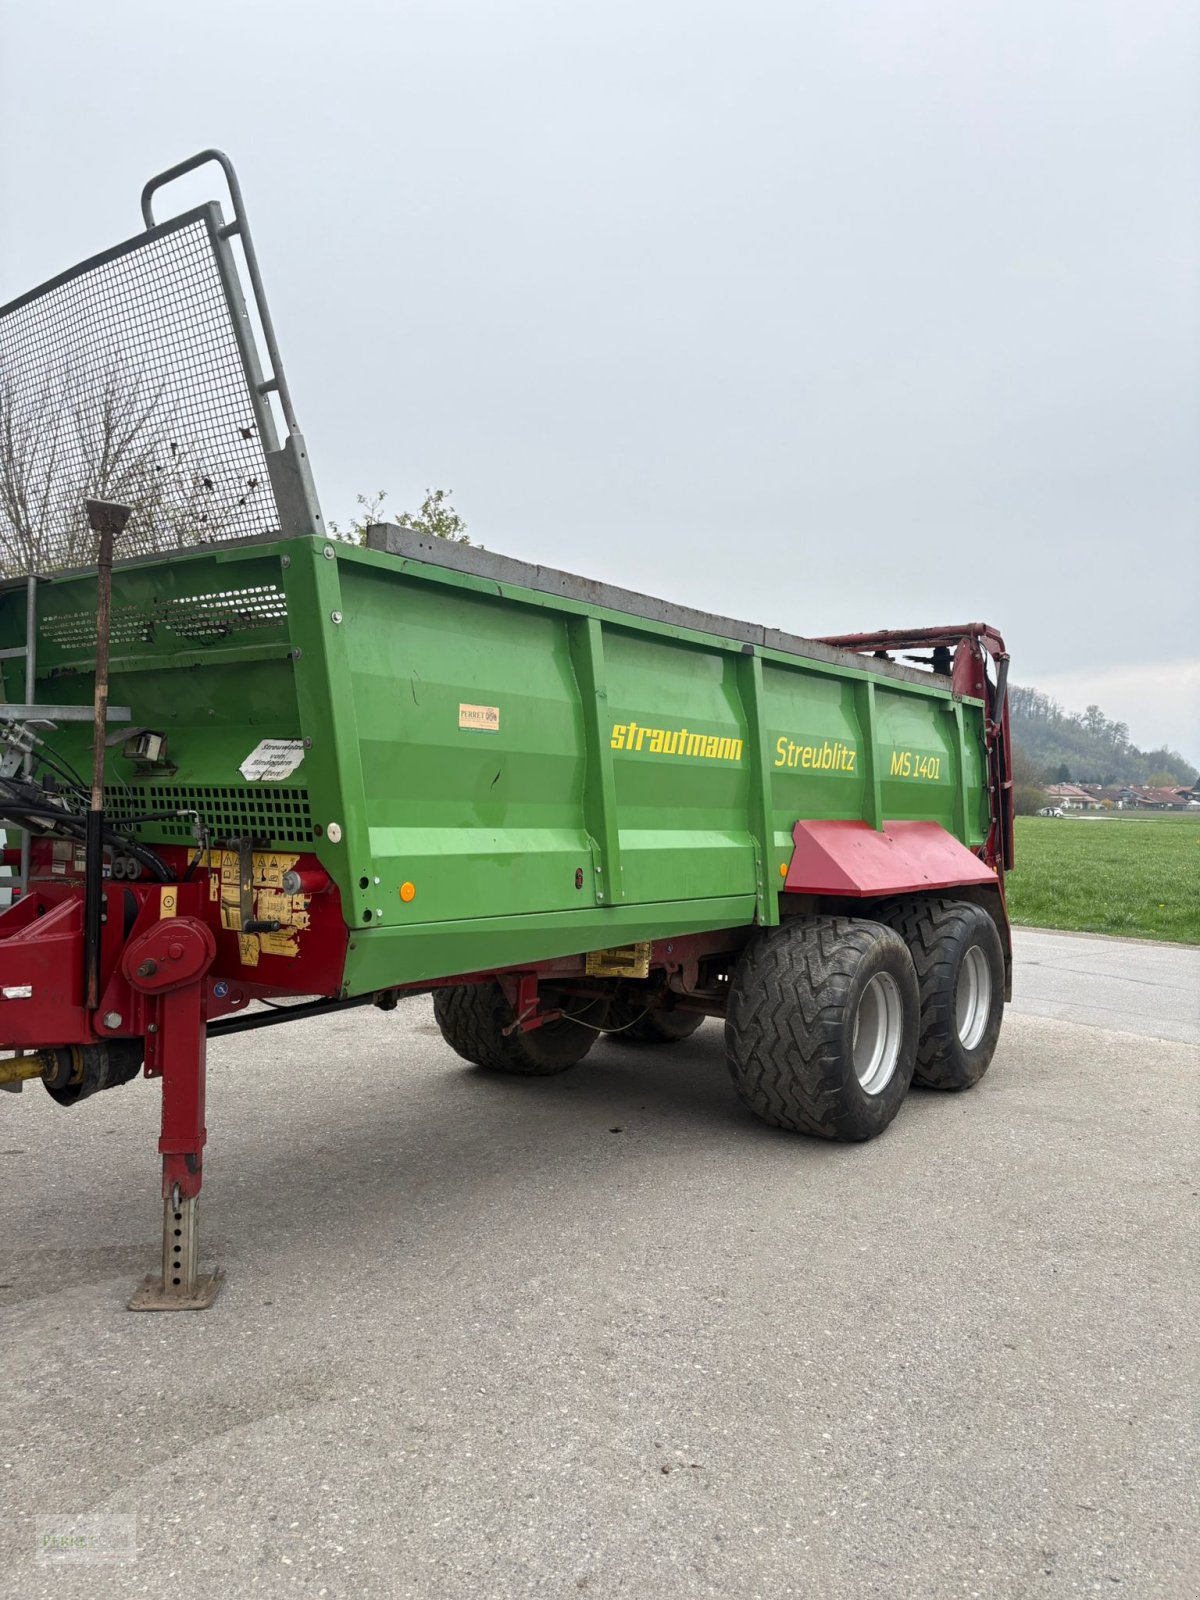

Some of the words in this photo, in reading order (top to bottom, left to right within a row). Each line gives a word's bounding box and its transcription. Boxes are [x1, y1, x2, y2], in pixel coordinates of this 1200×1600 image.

[461, 711, 486, 719] PERRET
[610, 722, 743, 760] strautmann
[774, 736, 856, 771] Streublitz
[890, 751, 911, 777] MS
[913, 755, 940, 779] 1401
